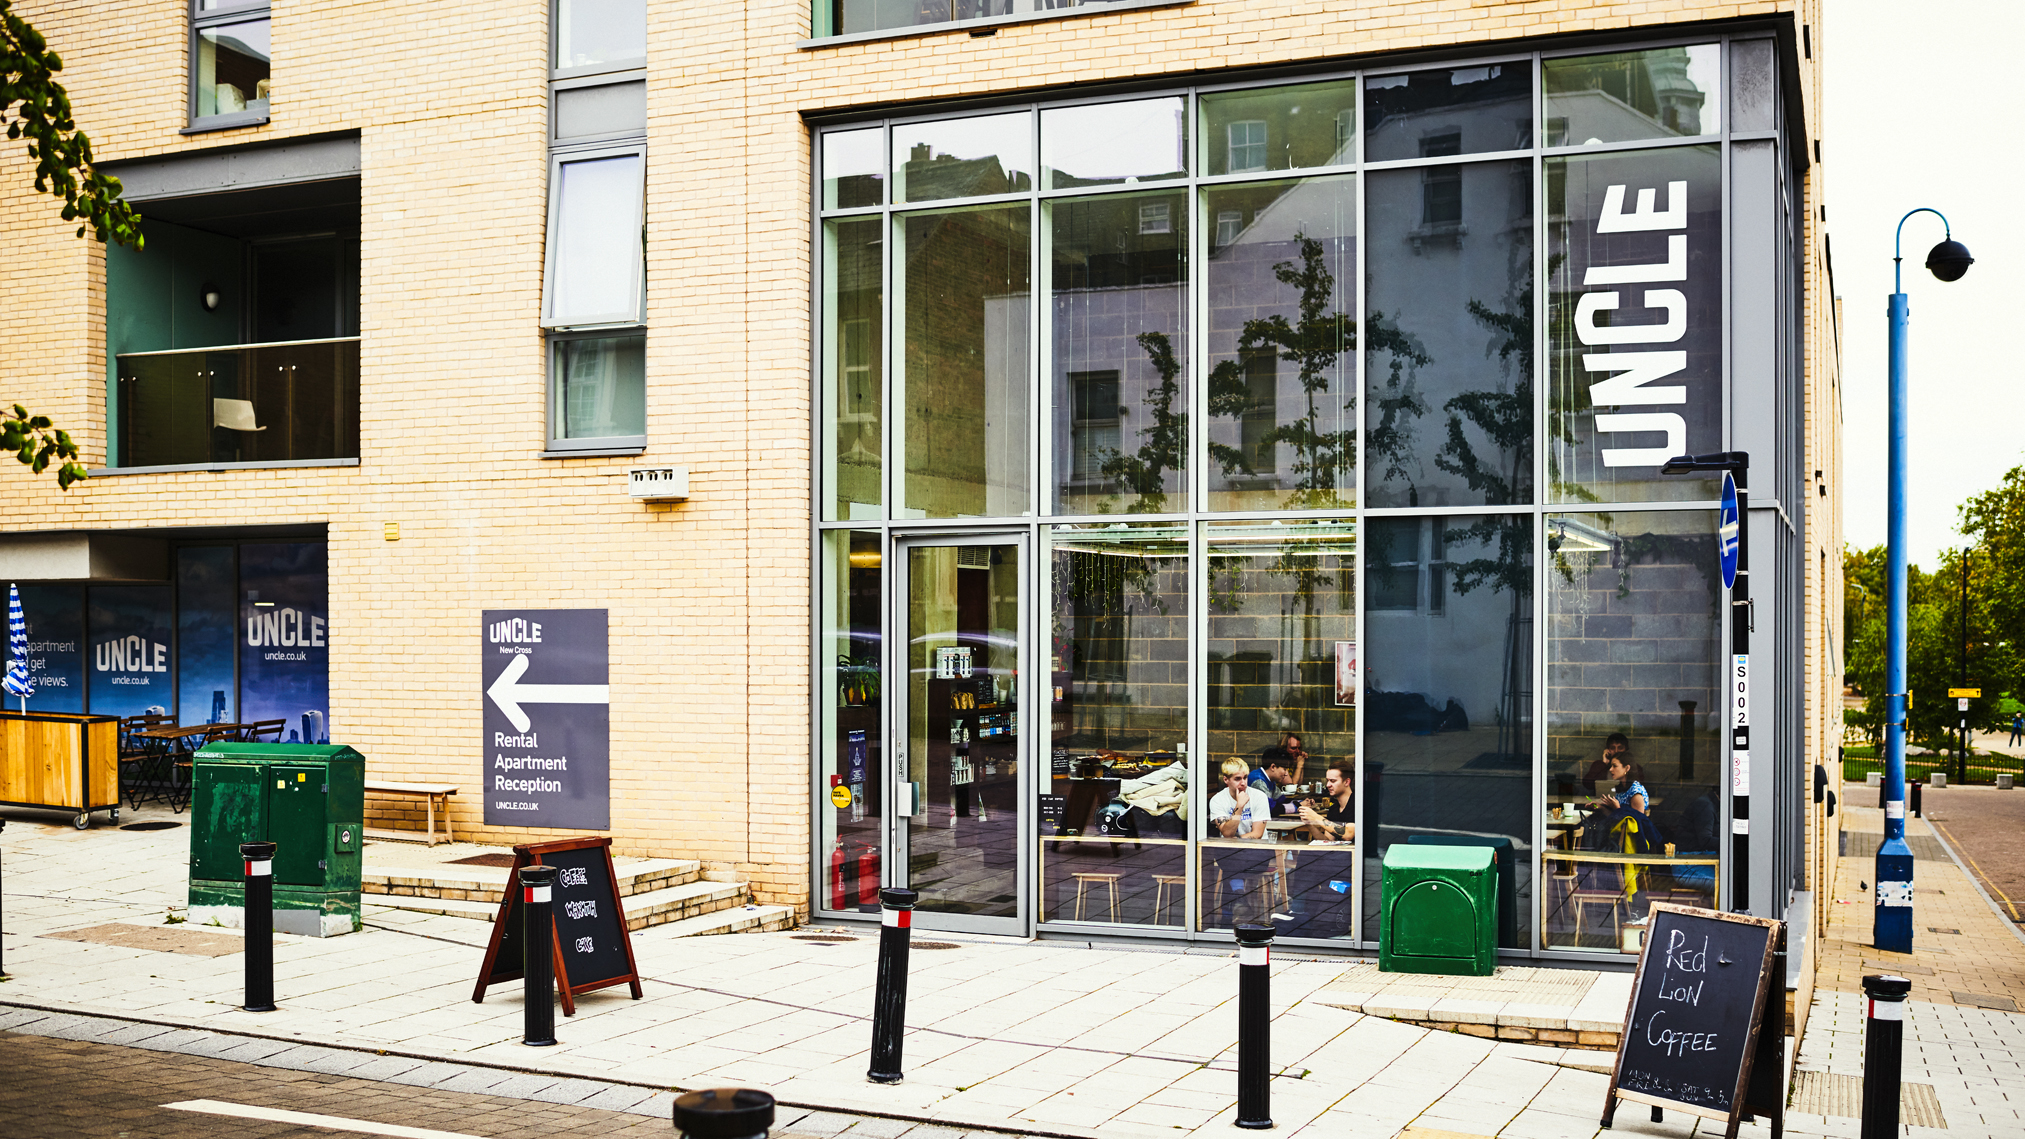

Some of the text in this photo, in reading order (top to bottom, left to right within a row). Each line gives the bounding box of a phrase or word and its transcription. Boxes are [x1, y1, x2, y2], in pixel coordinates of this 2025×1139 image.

[1574, 180, 1688, 468] UNCLE
[247, 607, 326, 648] UNCLE
[489, 617, 543, 644] UNCLE
[96, 634, 168, 673] UNCLE
[264, 650, 307, 661] uncle.co.uk
[499, 646, 533, 654] New Cross
[30, 657, 46, 672] get
[38, 673, 69, 687] views.
[111, 675, 150, 686] uncle.co.uk
[1737, 665, 1747, 724] S002
[494, 731, 539, 749] Rental
[494, 753, 568, 773] Apartment
[495, 775, 562, 795] Reception
[495, 801, 540, 811] UNCLE.CO.UK
